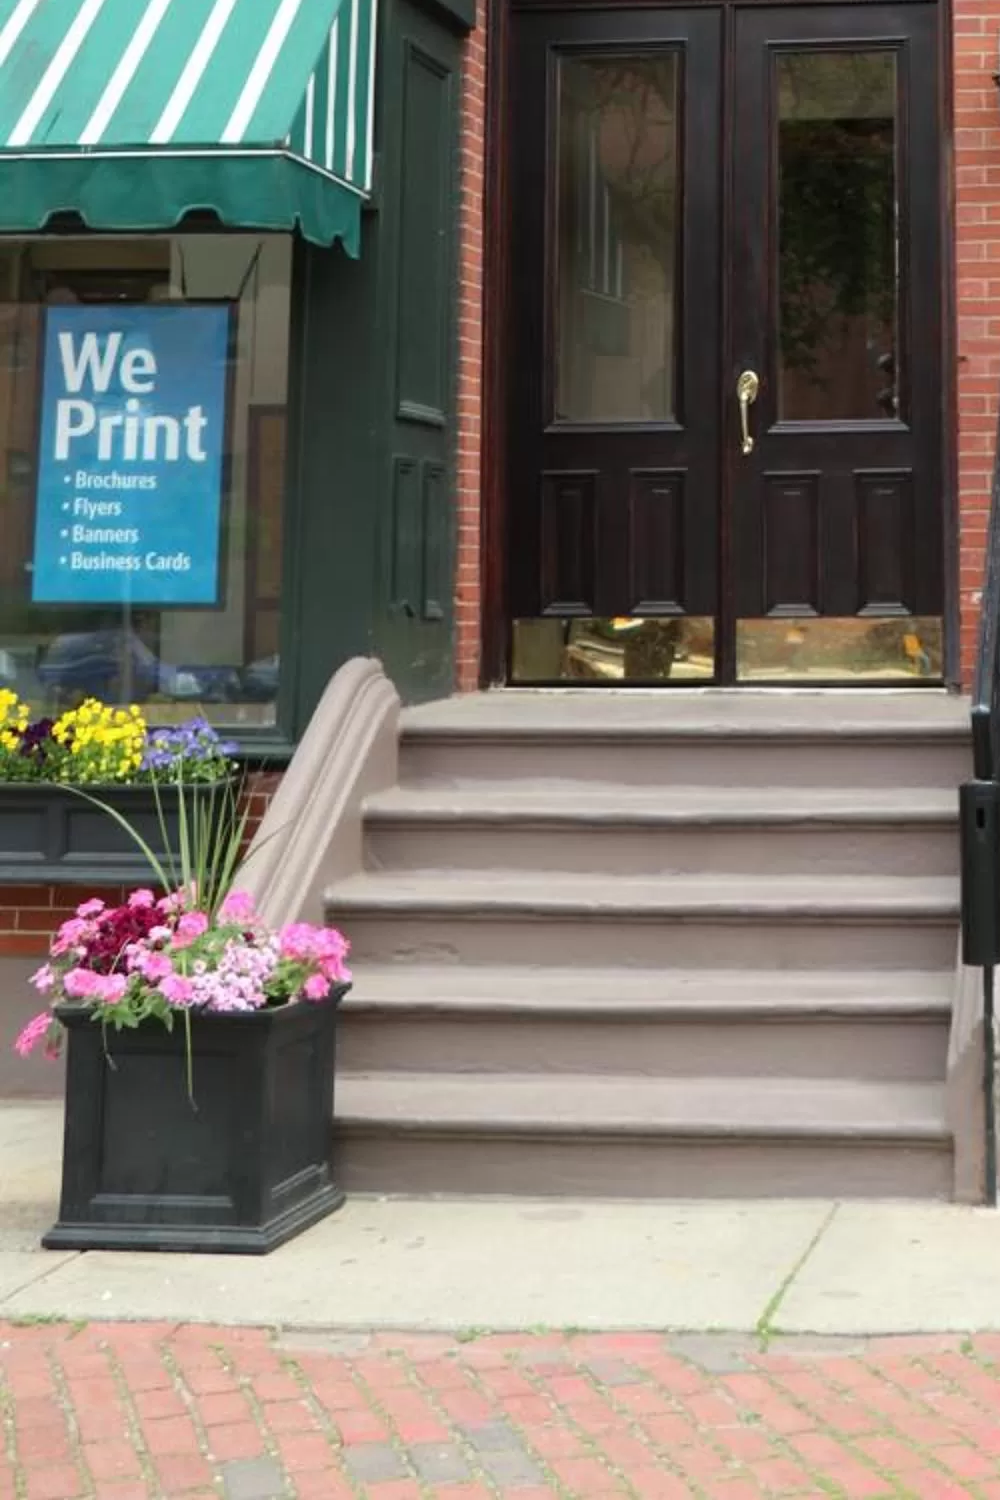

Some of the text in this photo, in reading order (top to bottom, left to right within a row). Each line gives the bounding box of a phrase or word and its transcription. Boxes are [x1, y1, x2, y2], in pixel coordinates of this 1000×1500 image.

[58, 331, 157, 393] We
[54, 398, 208, 461] Print
[75, 470, 157, 490] Brochures
[73, 498, 122, 520] Flyers
[72, 525, 139, 544] Banners
[71, 551, 191, 571] Business Cards
